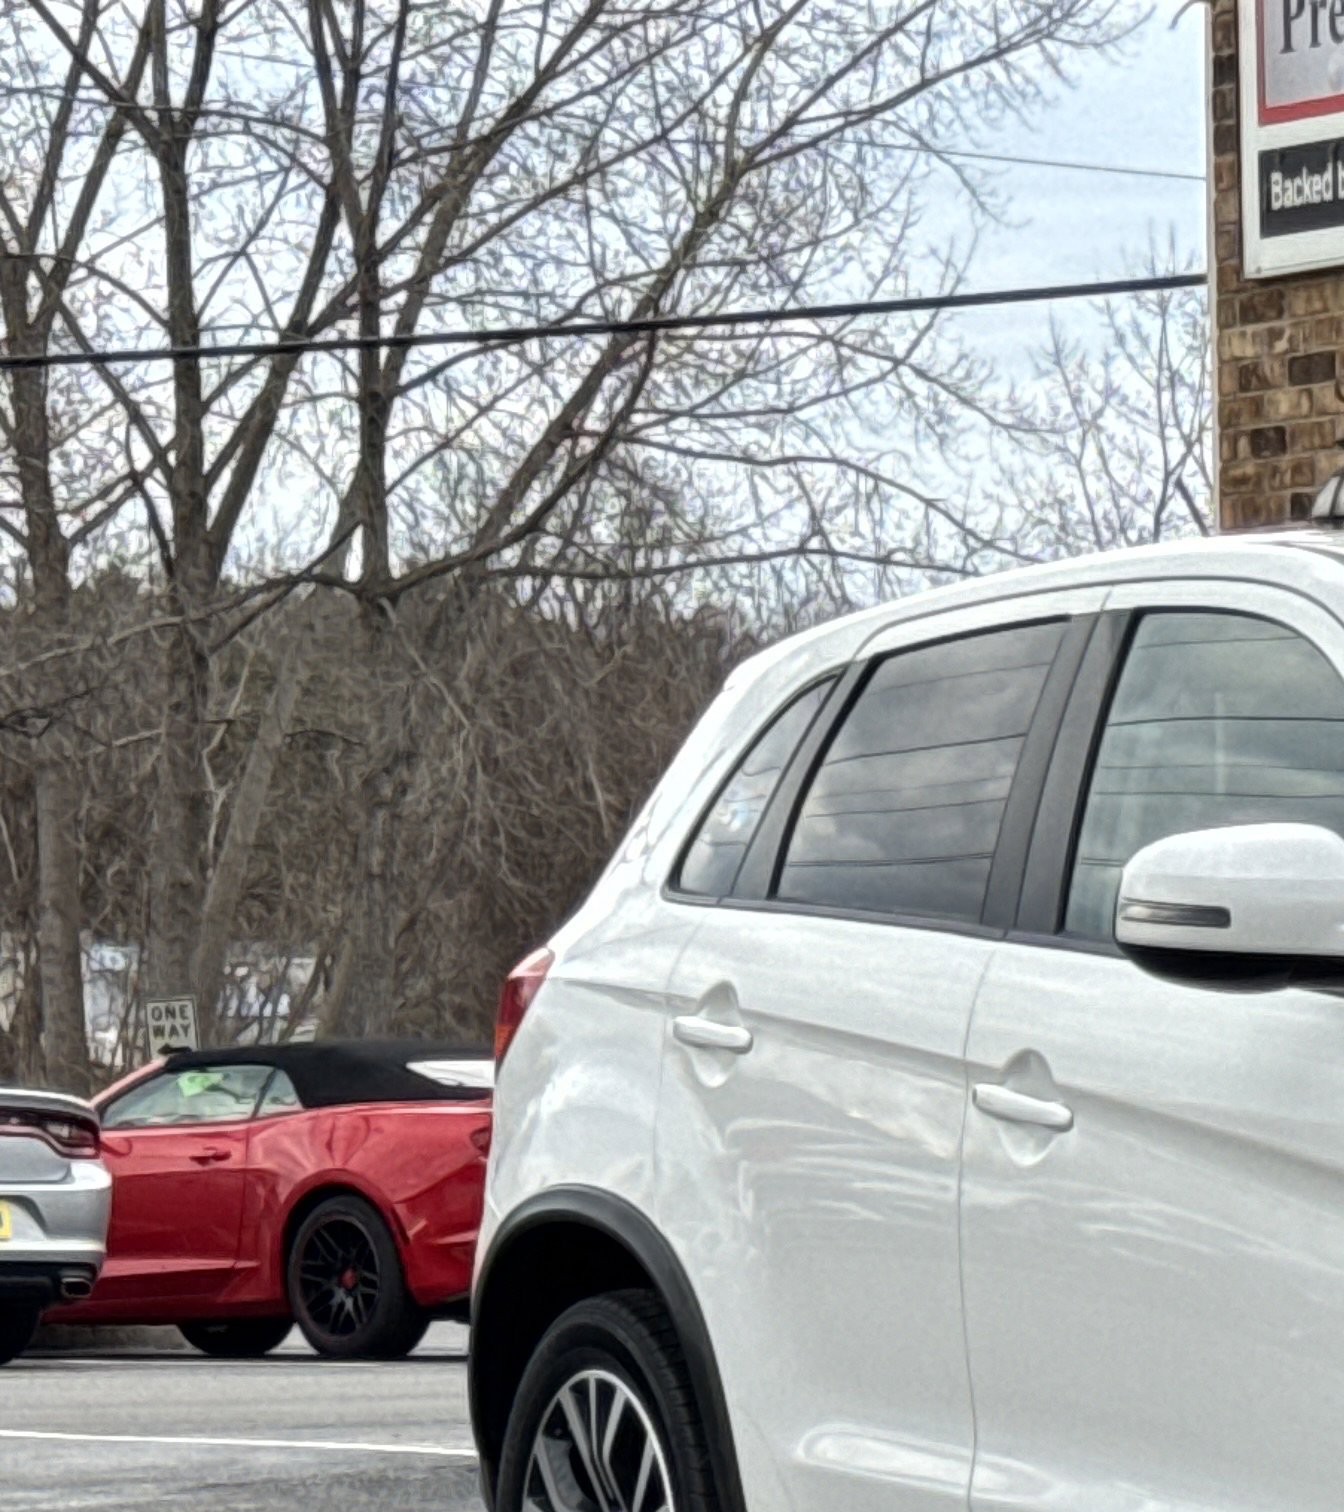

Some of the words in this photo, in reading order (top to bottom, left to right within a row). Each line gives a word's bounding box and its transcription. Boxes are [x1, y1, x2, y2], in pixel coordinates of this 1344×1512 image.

[1270, 164, 1333, 211] Backed
[151, 1004, 190, 1021] ONE
[152, 1022, 192, 1041] WAY
